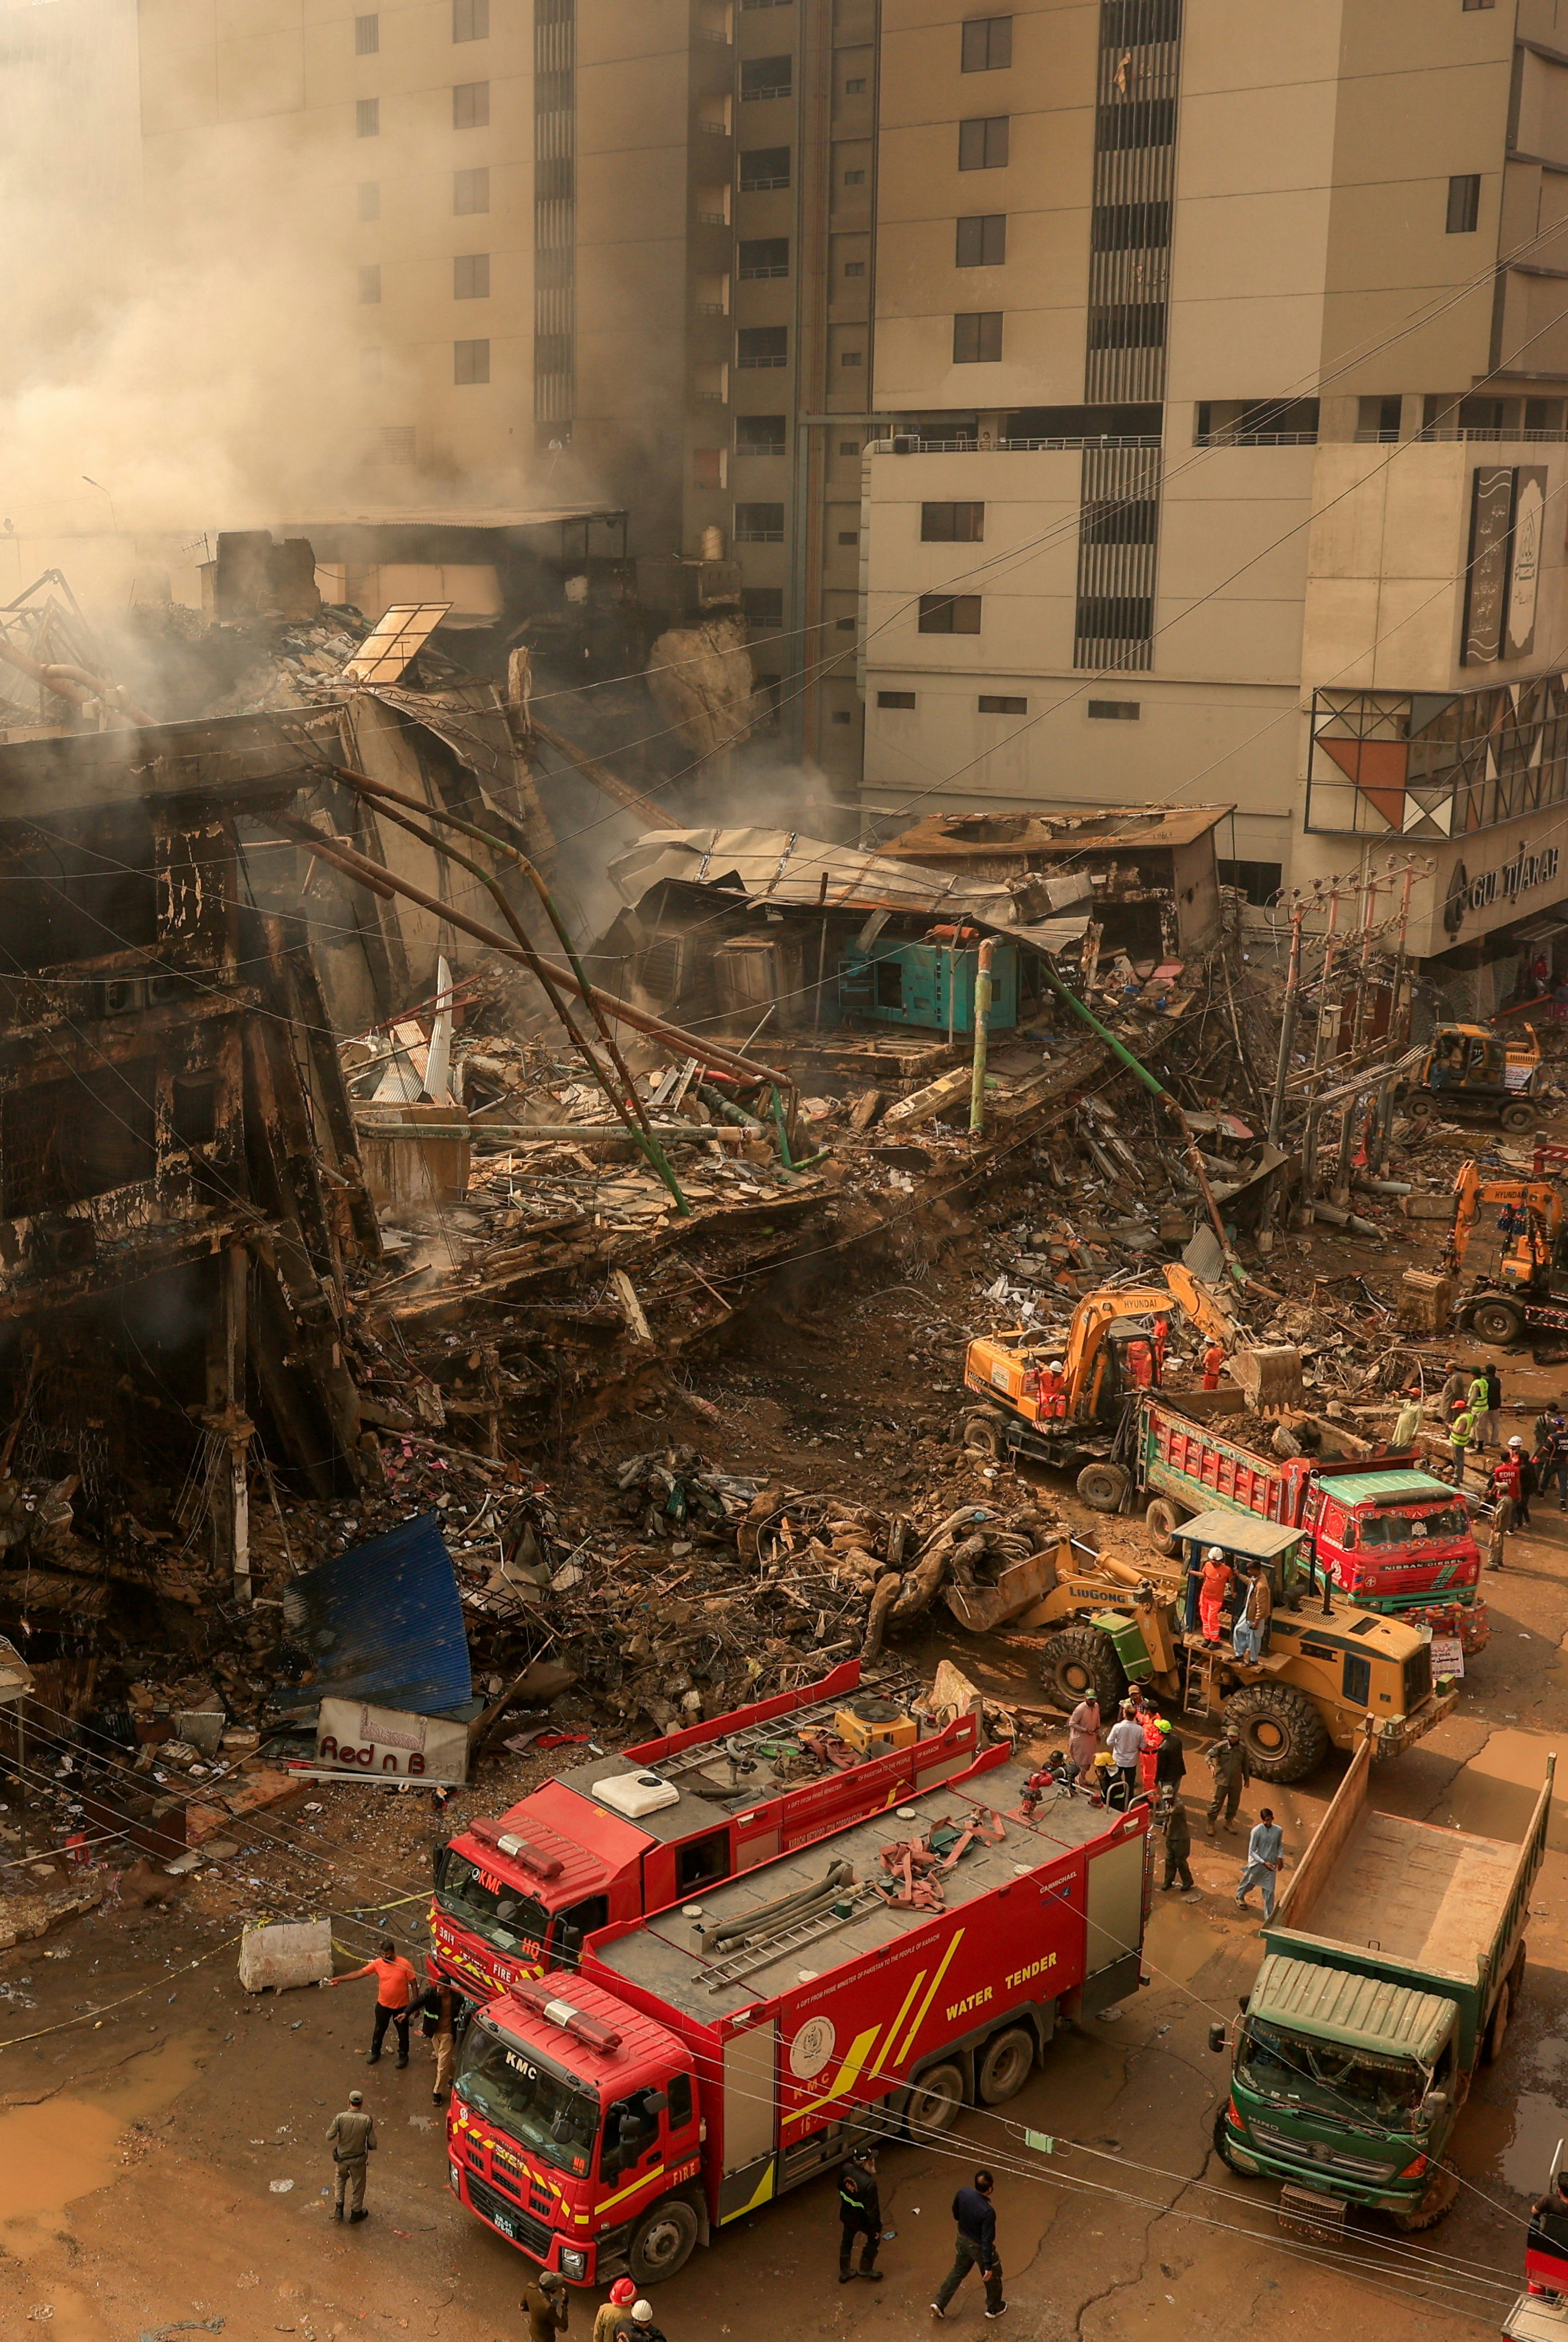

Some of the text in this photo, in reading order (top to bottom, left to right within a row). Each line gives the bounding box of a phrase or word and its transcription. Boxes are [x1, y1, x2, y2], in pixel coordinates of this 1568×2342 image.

[1472, 840, 1560, 909] GUL TIJARAH
[1124, 1299, 1157, 1308] HYUNDAI
[320, 1736, 374, 1766] Red
[383, 1754, 396, 1771] n
[800, 1795, 812, 1805] FROM
[824, 1783, 842, 1796] MINISTER
[864, 1768, 882, 1779] PAKISTAN
[896, 1756, 911, 1765] PEOPLE
[923, 1745, 939, 1755] KARACHI
[789, 1835, 806, 1849] KARACHI
[478, 1869, 502, 1895] KMC
[1040, 1871, 1077, 1893] CARMICHAEL
[522, 1938, 540, 1961] HQ
[493, 1963, 511, 1983] FIRE
[800, 1998, 810, 2007] GIFT
[810, 1991, 823, 2002] FROM
[823, 1984, 837, 1995] PRIME
[837, 1975, 856, 1989] MINISTER
[863, 1962, 884, 1976] PAKISTAN
[891, 1954, 899, 1963] THE
[898, 1947, 915, 1959] PEOPLE
[922, 1933, 940, 1947] KARACHI
[946, 1952, 1057, 2021] WATER TENDER
[506, 2051, 537, 2080] KMC
[461, 2110, 467, 2119] 51
[1248, 2116, 1279, 2131] HINO
[673, 2163, 695, 2186] FIRE
